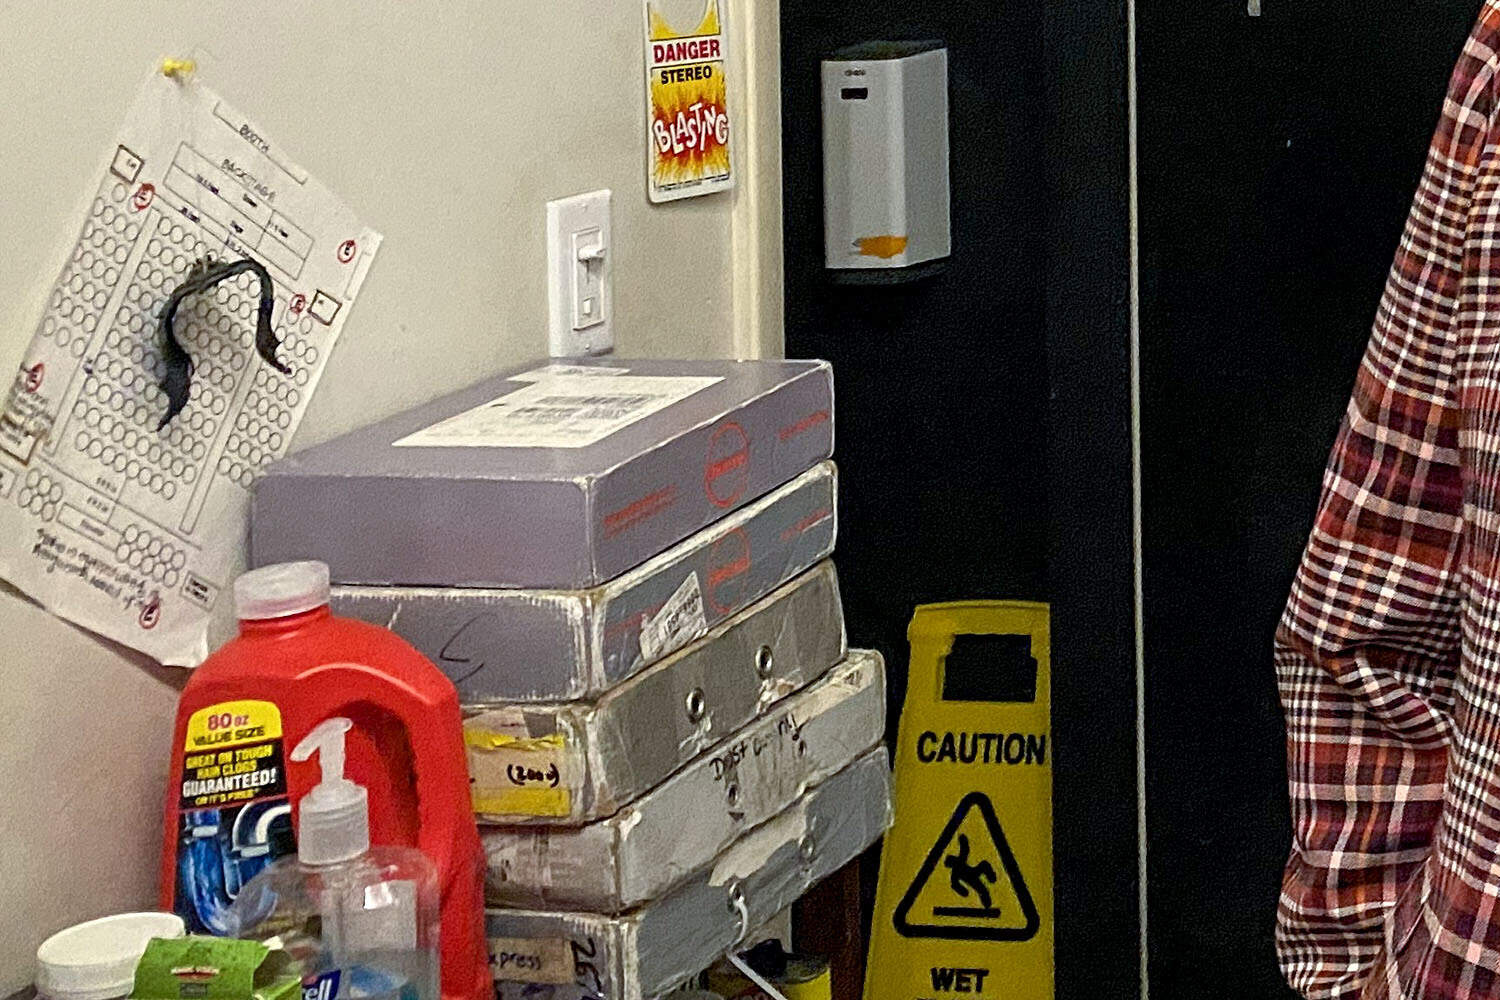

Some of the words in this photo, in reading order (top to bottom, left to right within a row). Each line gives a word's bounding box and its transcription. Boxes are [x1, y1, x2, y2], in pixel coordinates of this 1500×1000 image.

[653, 38, 721, 64] DANGER
[660, 65, 713, 85] STEREO
[653, 102, 730, 154] BLASTING
[208, 713, 232, 730] 80
[193, 731, 232, 746] VALUE
[235, 726, 265, 740] SIZE
[916, 731, 1046, 765] CAUTION
[183, 768, 277, 798] GUARANTEED!
[930, 966, 990, 993] WET
